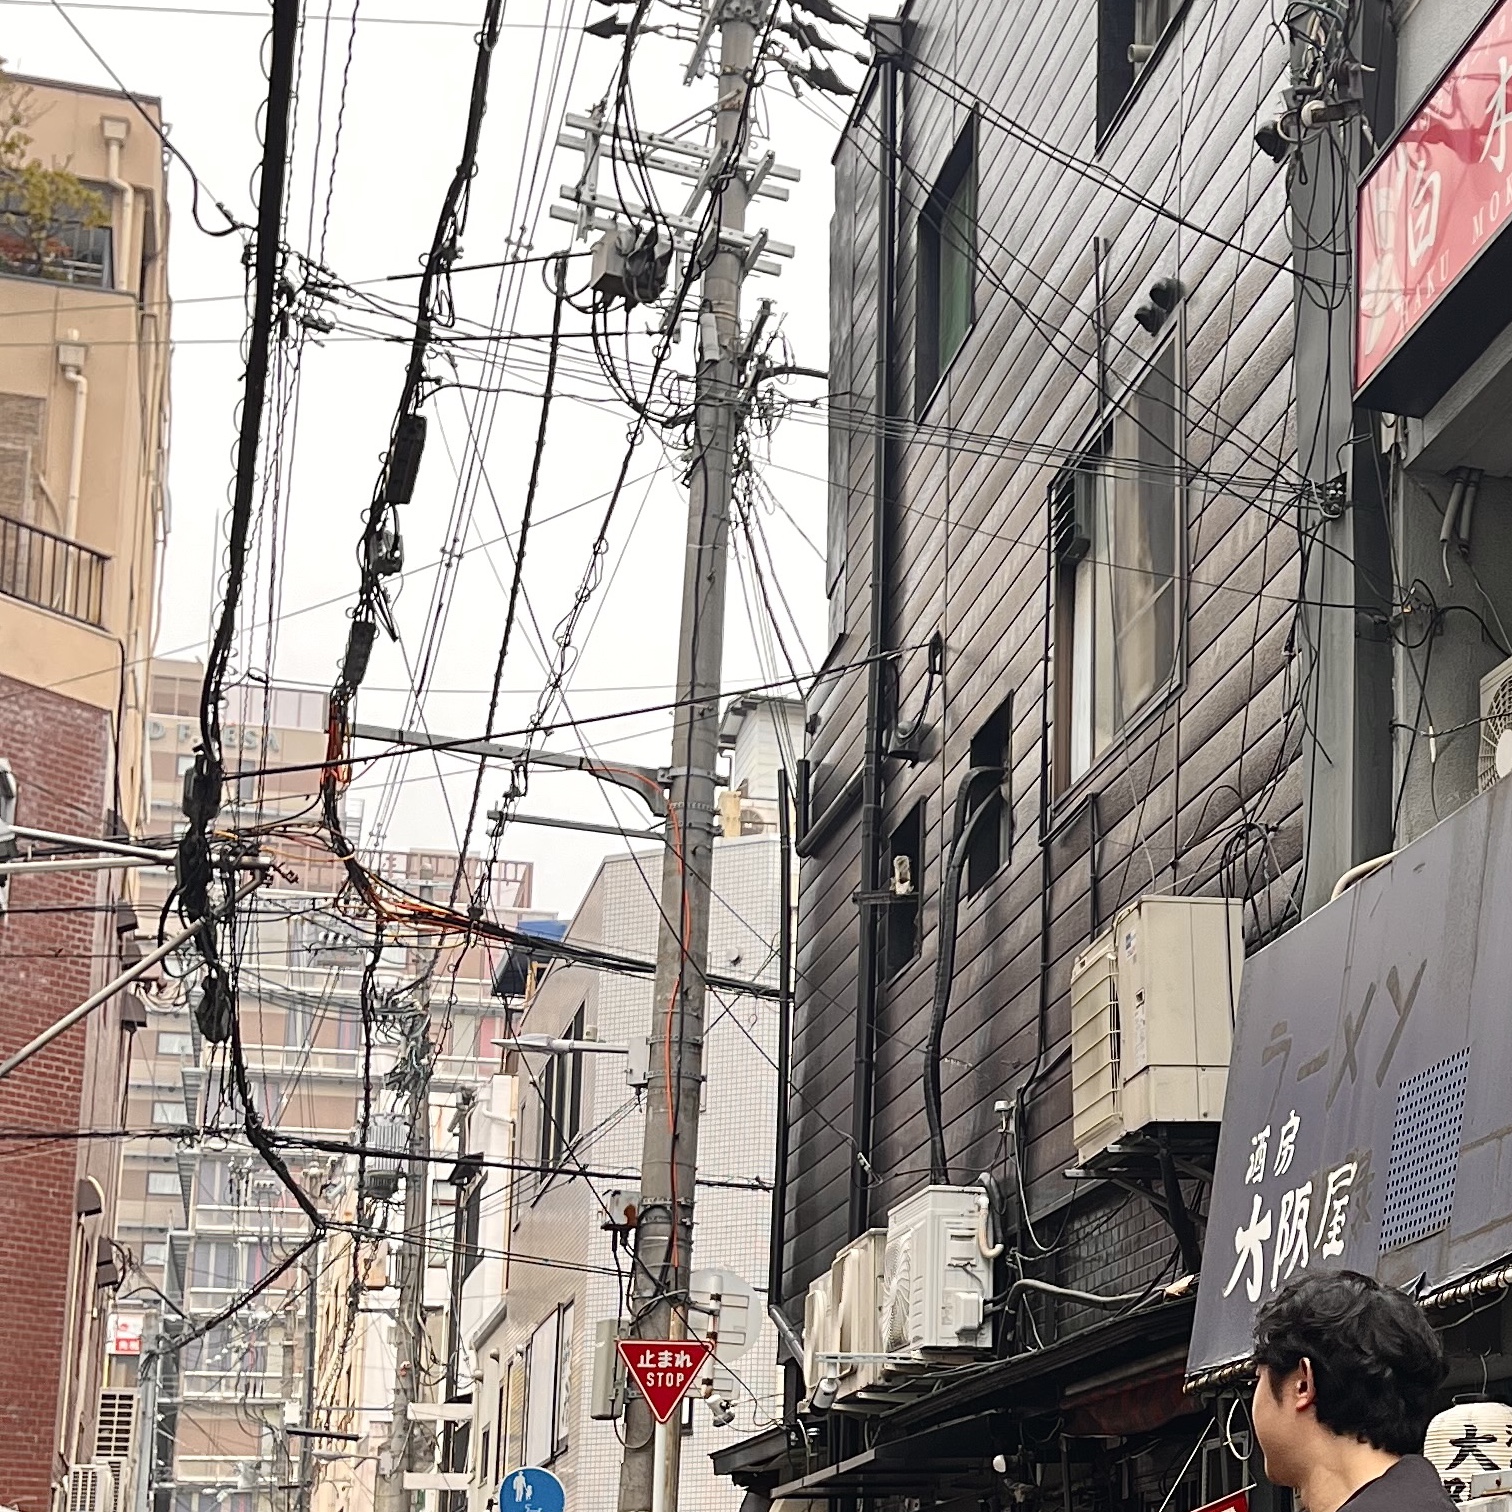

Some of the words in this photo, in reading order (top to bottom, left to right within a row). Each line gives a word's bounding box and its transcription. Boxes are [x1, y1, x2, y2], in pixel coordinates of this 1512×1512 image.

[1401, 251, 1448, 333] HAKU
[1245, 1110, 1301, 1185] 酒房
[1223, 1162, 1358, 1302] 大阪屋
[637, 1350, 694, 1370] 止まれ
[646, 1372, 685, 1388] STOP
